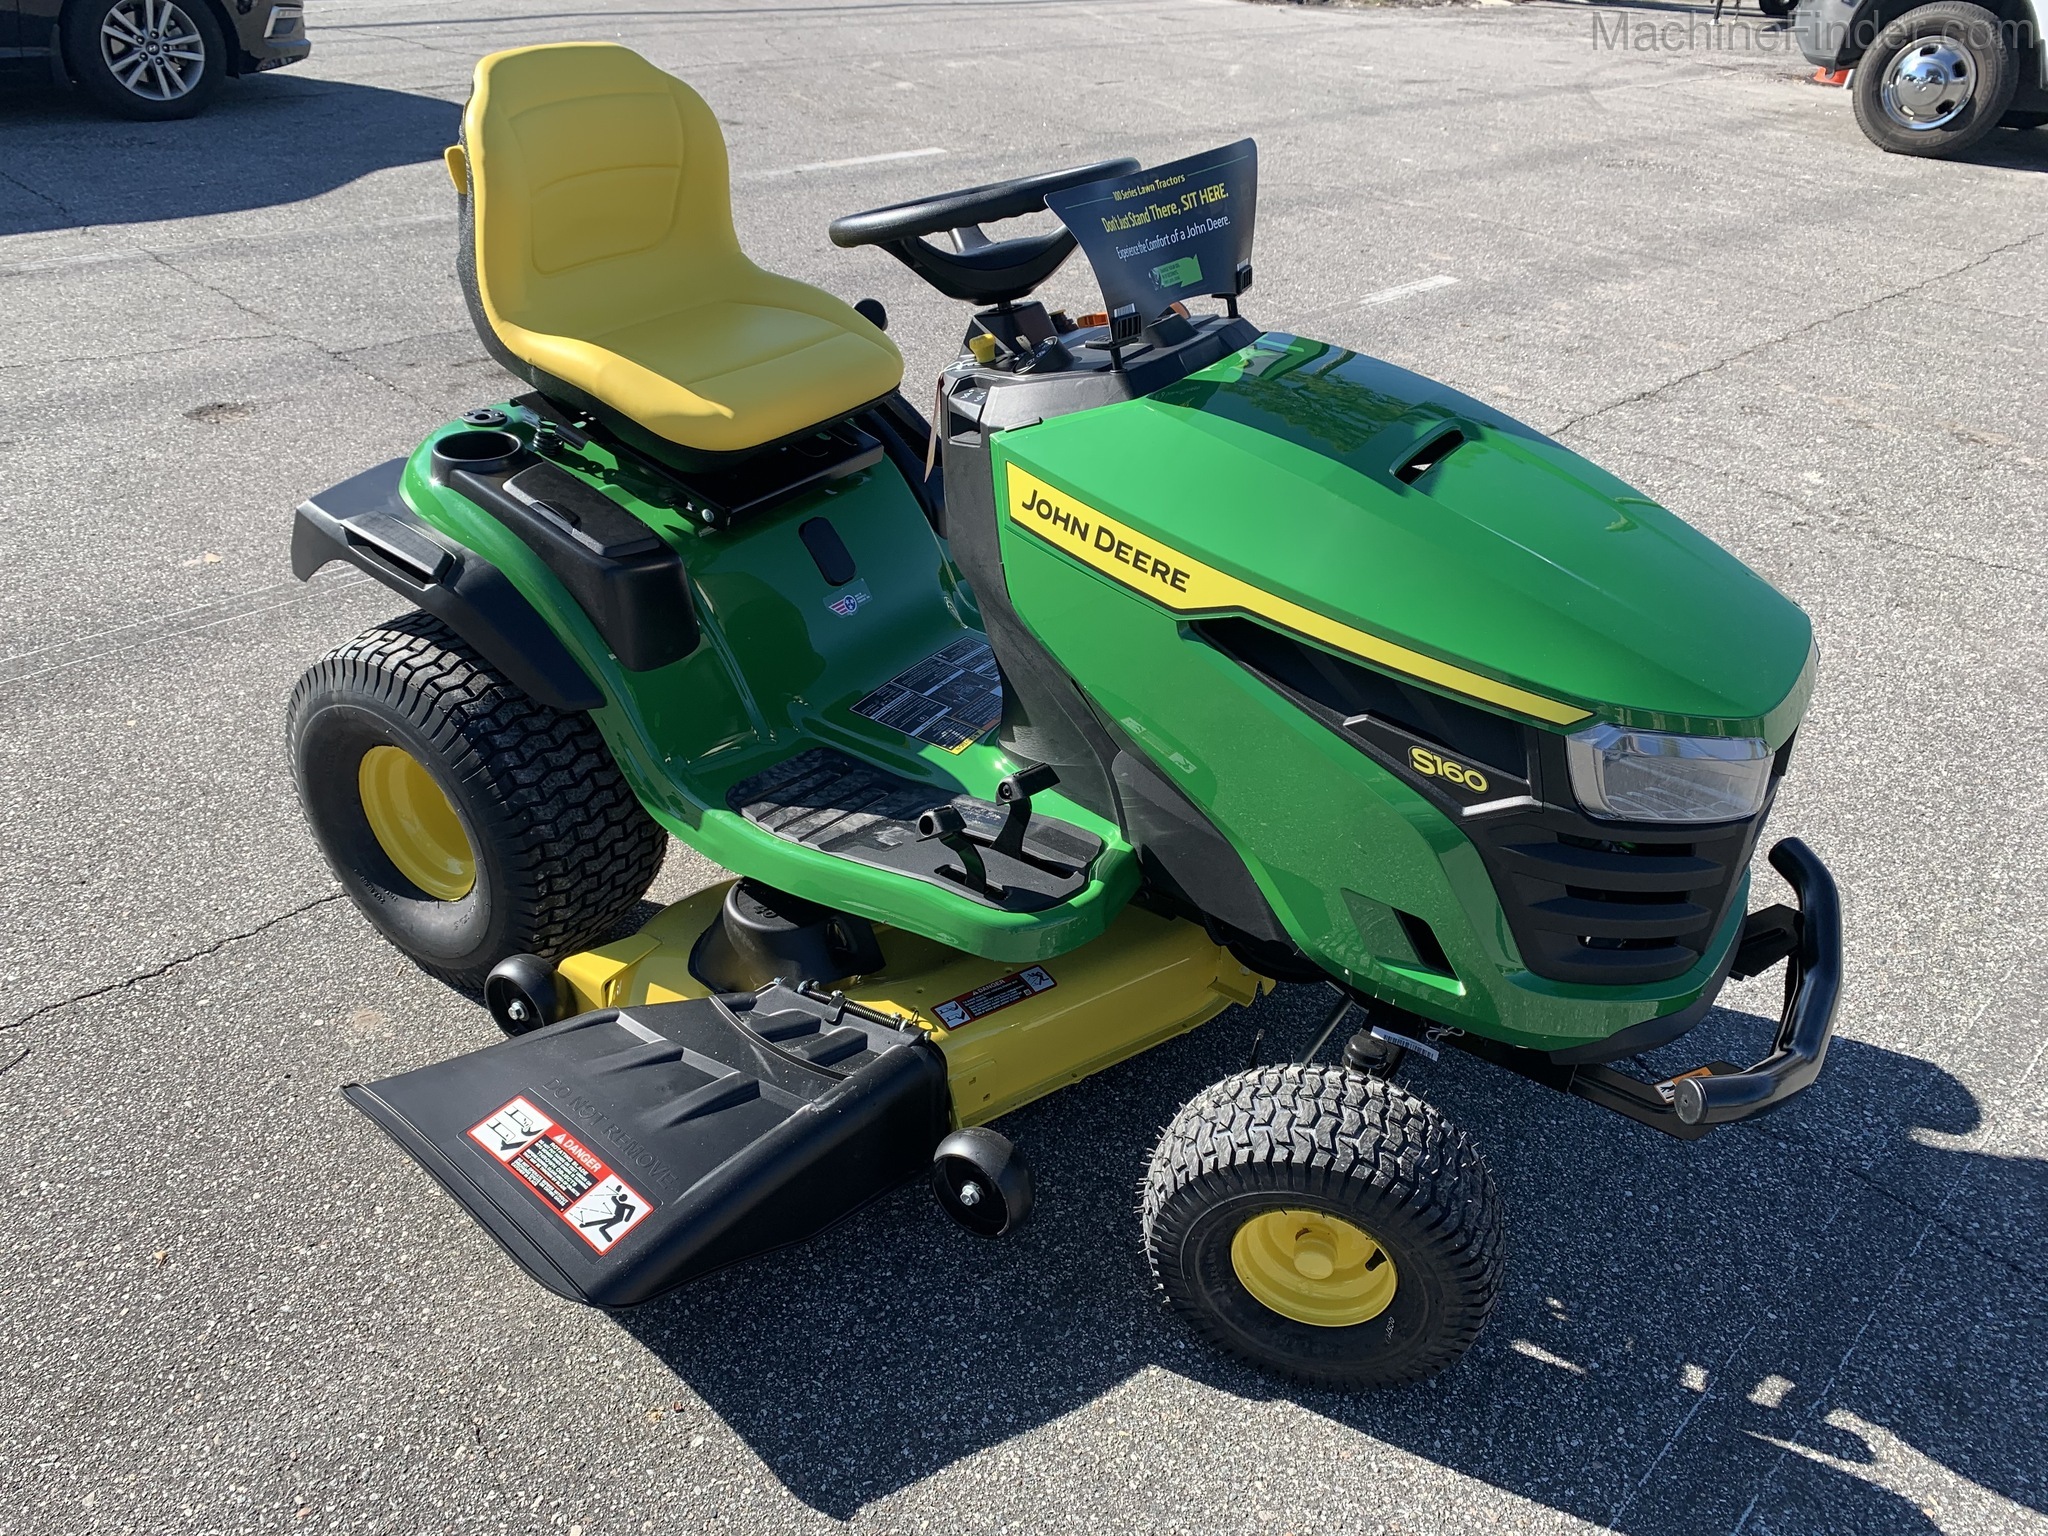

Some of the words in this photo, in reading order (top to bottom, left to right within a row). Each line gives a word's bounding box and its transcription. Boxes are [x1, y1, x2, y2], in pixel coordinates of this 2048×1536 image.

[1101, 214, 1120, 233] Don't
[1117, 214, 1131, 230] Just
[1128, 206, 1151, 227] Stand
[1149, 203, 1181, 220] There,
[1180, 191, 1199, 211] SIT
[1199, 182, 1229, 206] HERE.
[1112, 190, 1122, 201] 100
[1121, 188, 1138, 200] Series
[1137, 183, 1155, 195] Lawn
[1155, 174, 1186, 190] Tractors
[1116, 244, 1141, 262] Experience
[1138, 241, 1148, 254] the
[1145, 234, 1171, 251] Comfort
[1170, 228, 1180, 243] of
[1180, 231, 1186, 240] a
[1186, 223, 1207, 239] John
[1206, 215, 1231, 231] Deere.
[1022, 489, 1090, 542] JOHN
[1094, 525, 1190, 593] DEERE
[1411, 747, 1488, 792] S160
[978, 979, 1006, 994] DANGER
[543, 1078, 573, 1099] DO
[568, 1097, 609, 1127] NOT
[603, 1122, 679, 1190] REMOVE
[562, 1139, 602, 1173] DANGER
